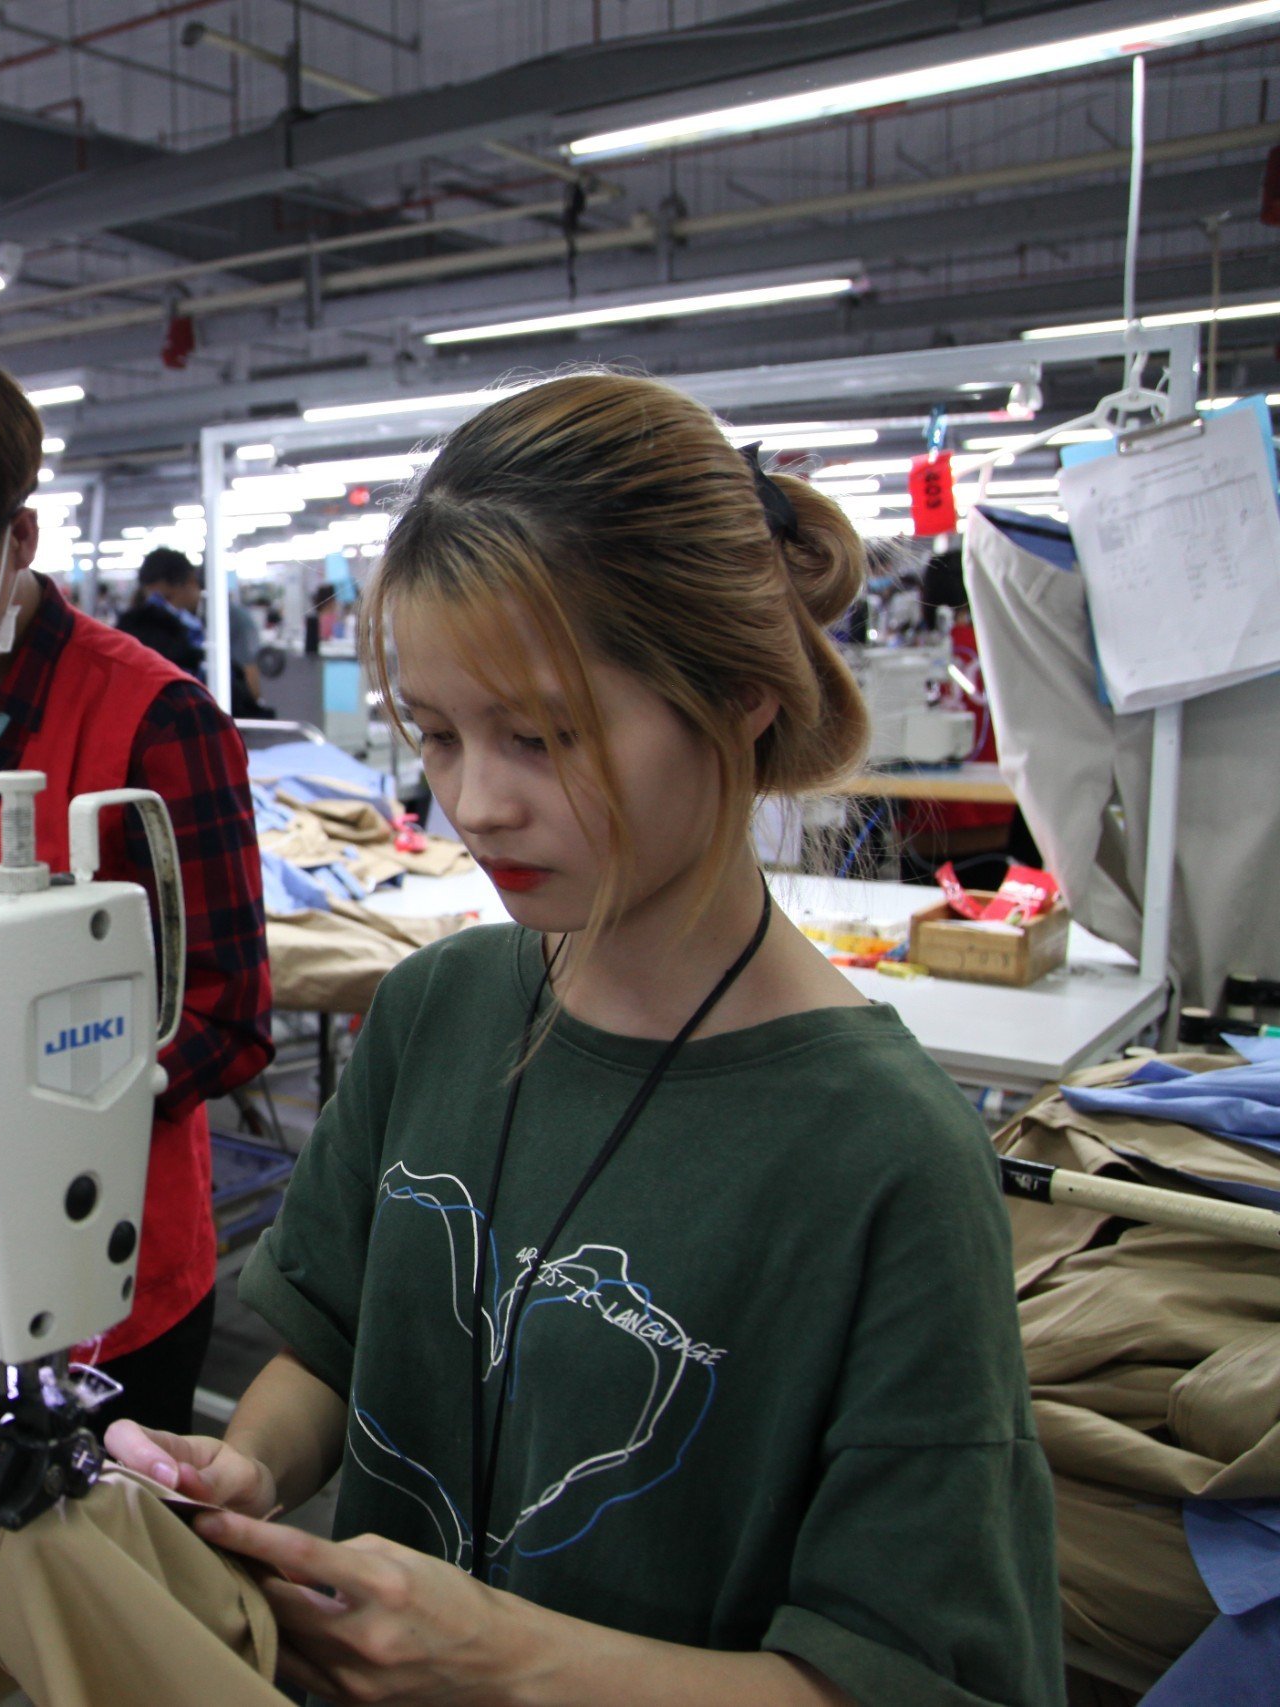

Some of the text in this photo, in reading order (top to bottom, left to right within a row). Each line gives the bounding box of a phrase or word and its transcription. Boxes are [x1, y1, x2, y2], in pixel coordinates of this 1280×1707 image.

[45, 1016, 124, 1055] JUKI
[516, 1247, 728, 1365] ARISTIC LANGUAGE
